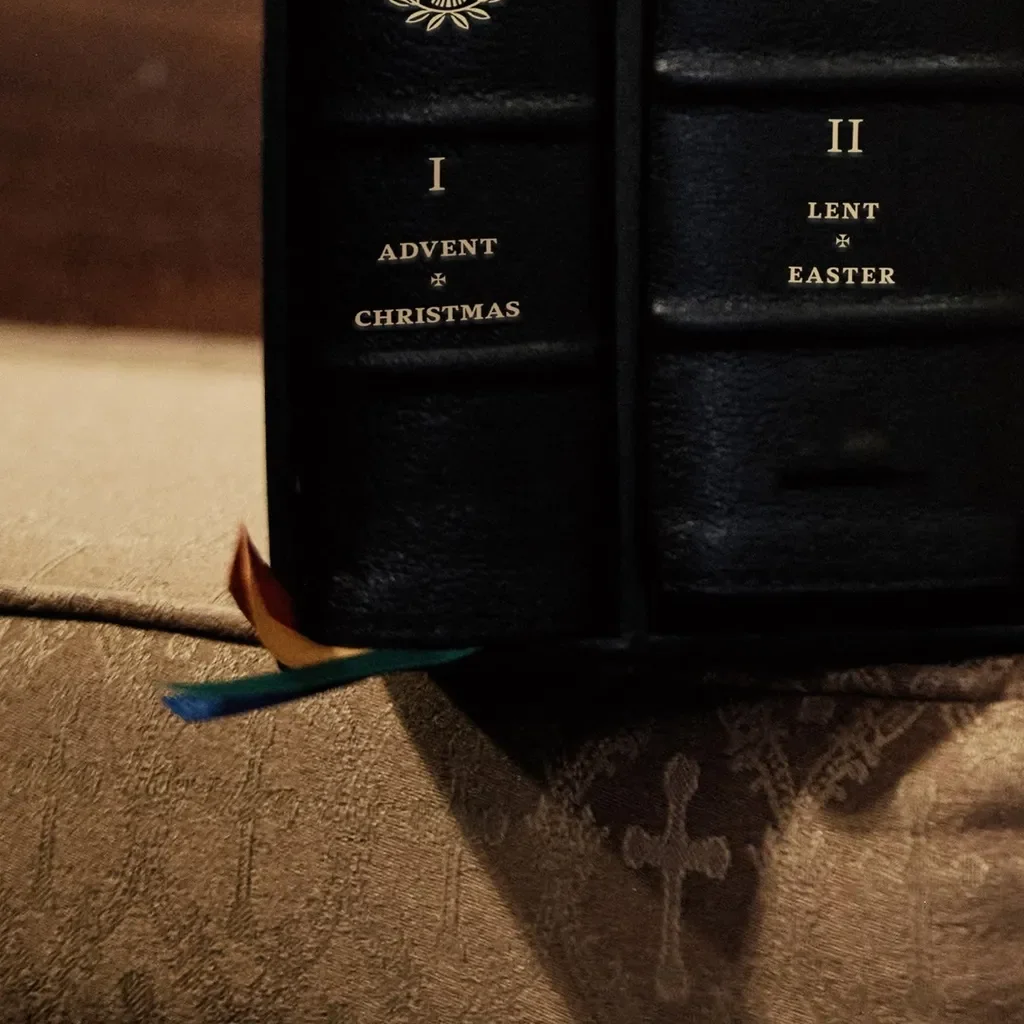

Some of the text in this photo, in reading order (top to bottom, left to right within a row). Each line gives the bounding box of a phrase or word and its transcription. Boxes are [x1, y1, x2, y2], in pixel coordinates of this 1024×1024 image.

[827, 118, 864, 154] II
[428, 156, 446, 192] I
[807, 201, 880, 220] LENT
[377, 237, 498, 262] ADVENT
[787, 266, 896, 285] EASTER
[354, 300, 521, 327] CHRISTMAS
